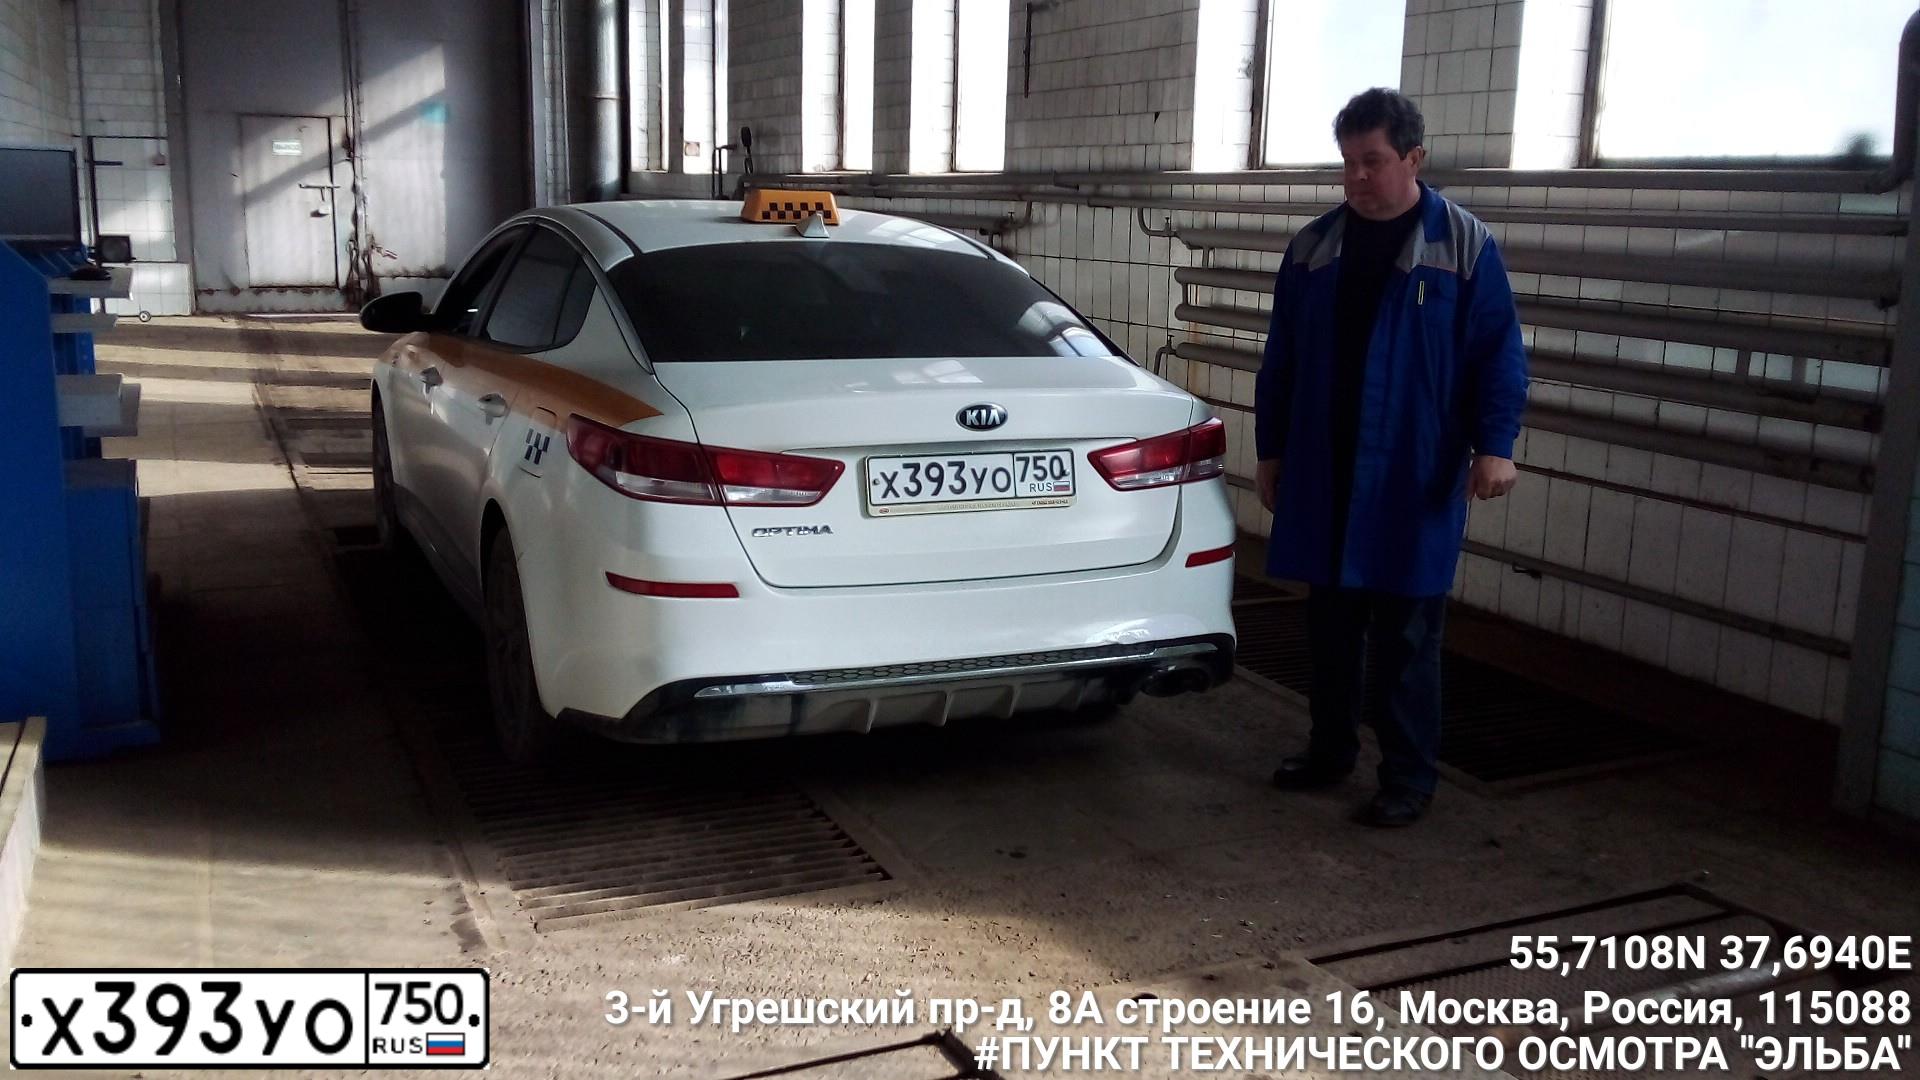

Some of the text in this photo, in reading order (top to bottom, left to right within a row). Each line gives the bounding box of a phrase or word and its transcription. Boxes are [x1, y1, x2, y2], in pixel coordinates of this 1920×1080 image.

[966, 409, 1001, 426] KIA
[1015, 454, 1066, 483] 750
[1029, 481, 1053, 493] RUS
[751, 524, 834, 538] OPTIMA
